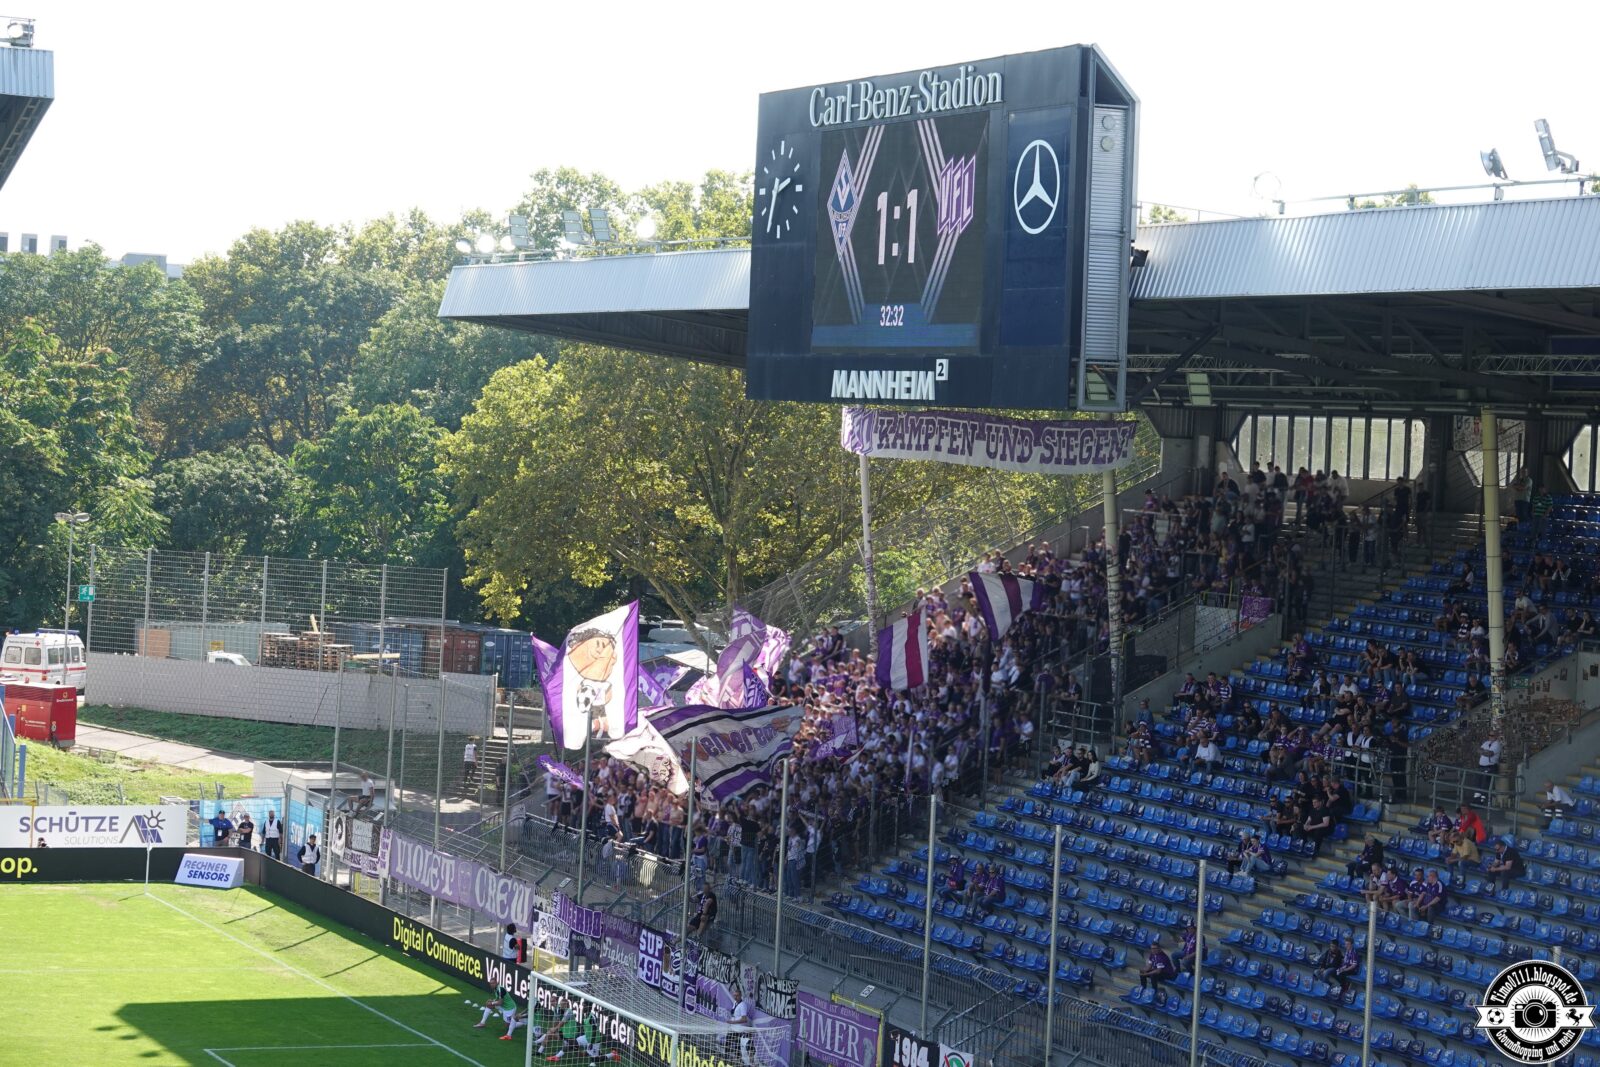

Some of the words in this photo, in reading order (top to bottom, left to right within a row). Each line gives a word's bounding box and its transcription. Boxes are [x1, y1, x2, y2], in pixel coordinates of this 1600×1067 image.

[809, 66, 1002, 127] Carl-Benz-Stadion
[877, 189, 918, 265] 1:1
[880, 305, 904, 327] 32:32
[831, 369, 935, 400] MANNHEIM
[937, 361, 948, 379] 2
[984, 423, 1035, 464] UND
[64, 835, 120, 845] SOLUTIONS
[184, 859, 228, 873] RECHNER
[187, 869, 230, 883] SENSORS
[395, 838, 455, 896] VIOLET
[640, 928, 663, 957] SUP
[393, 917, 424, 952] Digital
[425, 931, 483, 980] Commerce.
[485, 957, 511, 993] Volle
[637, 1023, 656, 1055] SV
[798, 1005, 860, 1063] EIMER
